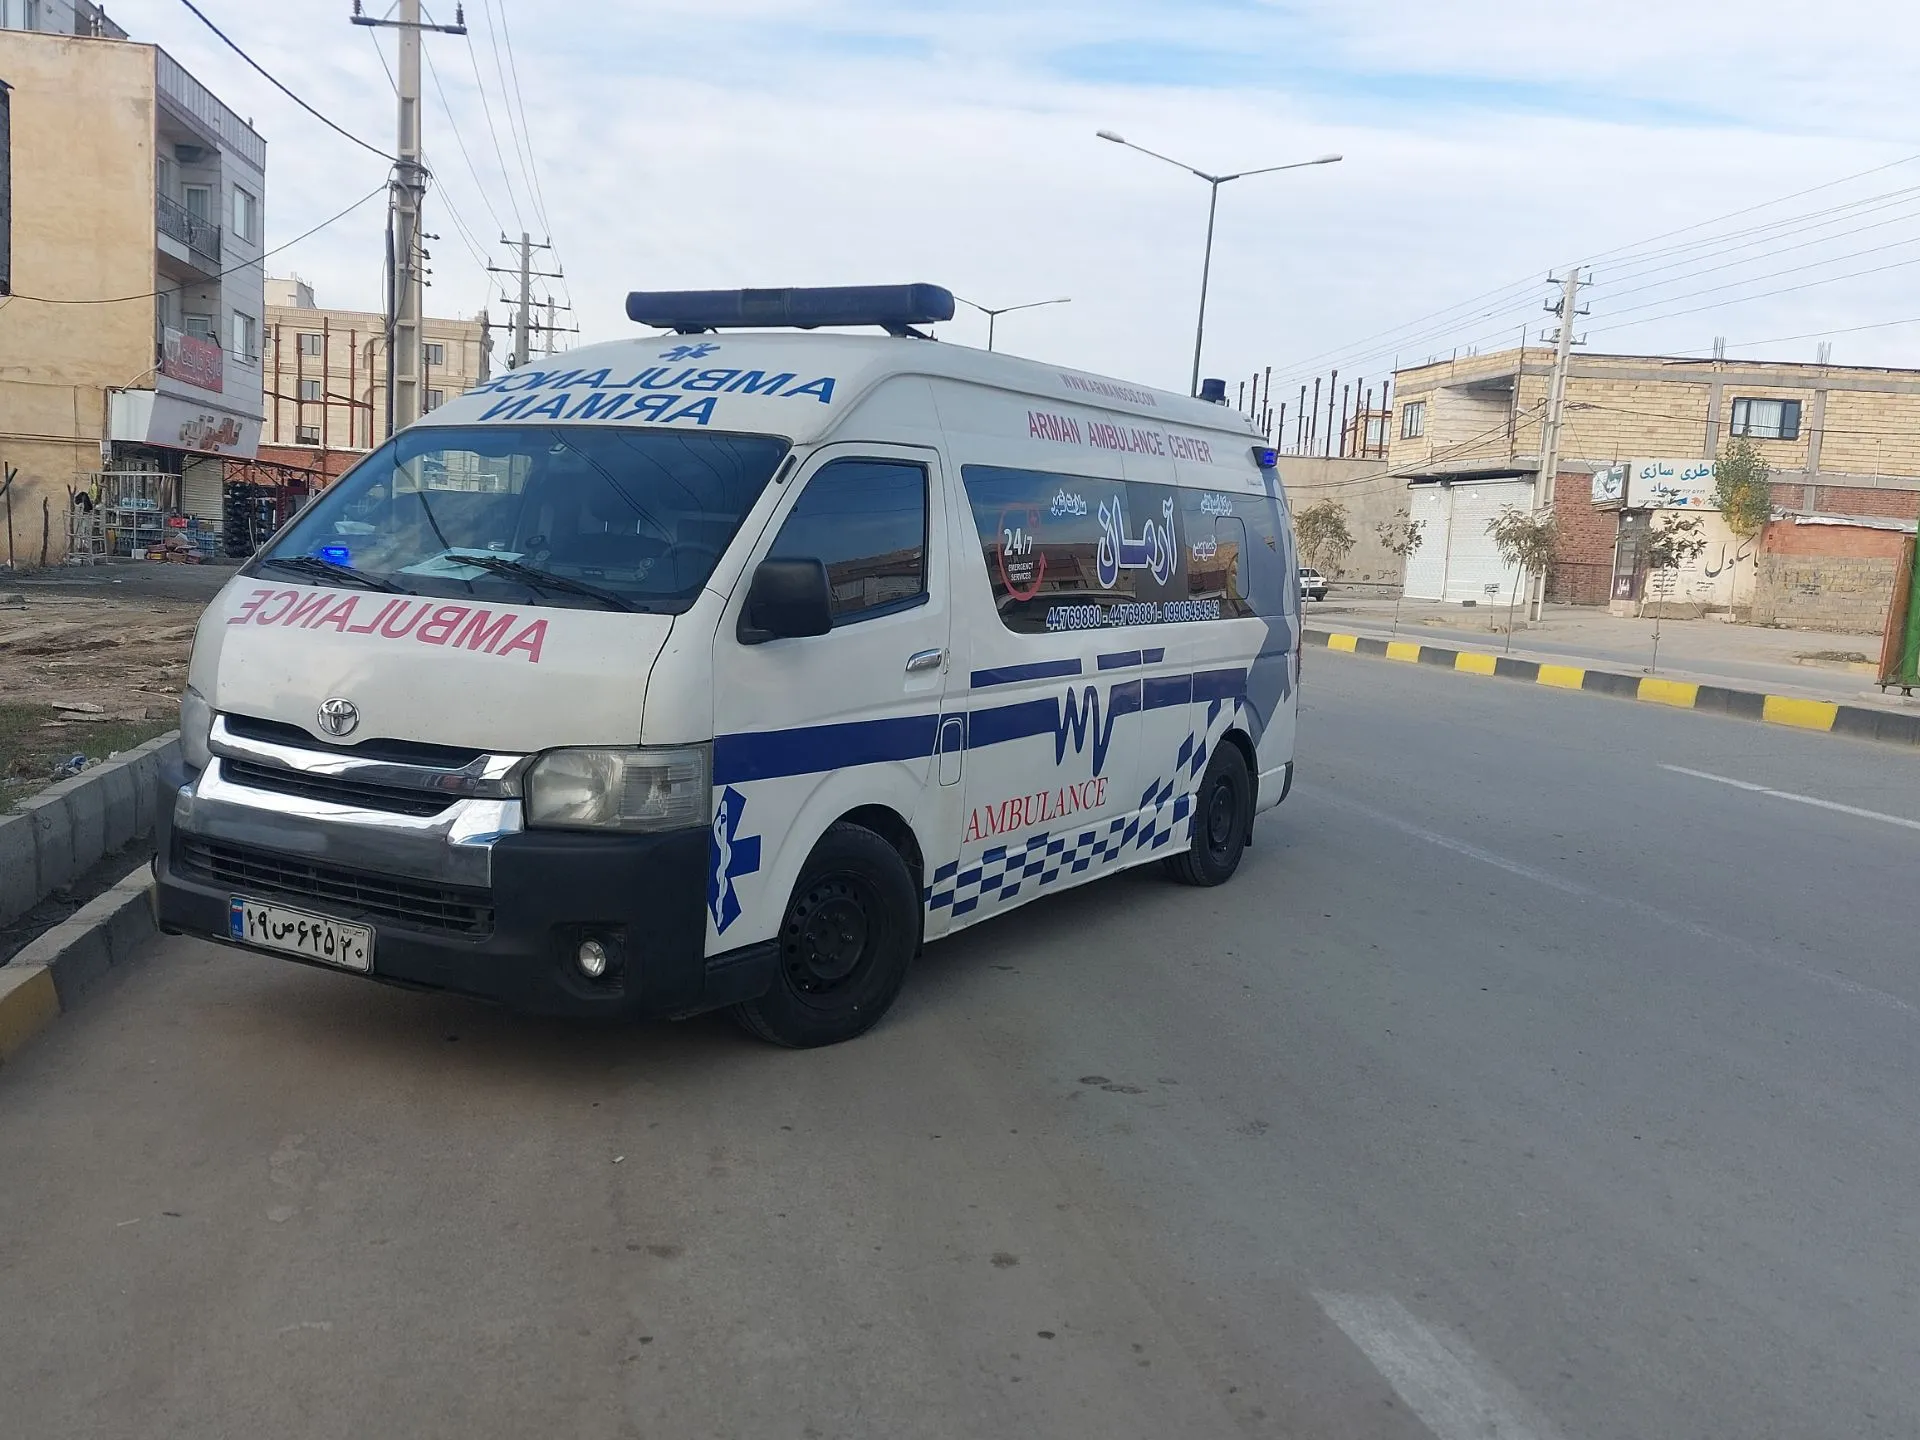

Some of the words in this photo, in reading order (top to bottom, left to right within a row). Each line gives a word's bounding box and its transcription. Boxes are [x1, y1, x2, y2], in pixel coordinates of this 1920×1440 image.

[1027, 410, 1082, 445] ARMAN
[1088, 421, 1165, 457] AMBULANCE
[1167, 434, 1213, 464] CENTER
[1639, 462, 1674, 480] سازی
[1680, 461, 1717, 481] اطری
[1003, 527, 1033, 556] 24/7
[1096, 494, 1178, 590] آرمان
[1046, 605, 1101, 631] 44769880
[962, 776, 1109, 844] AMBULANCE
